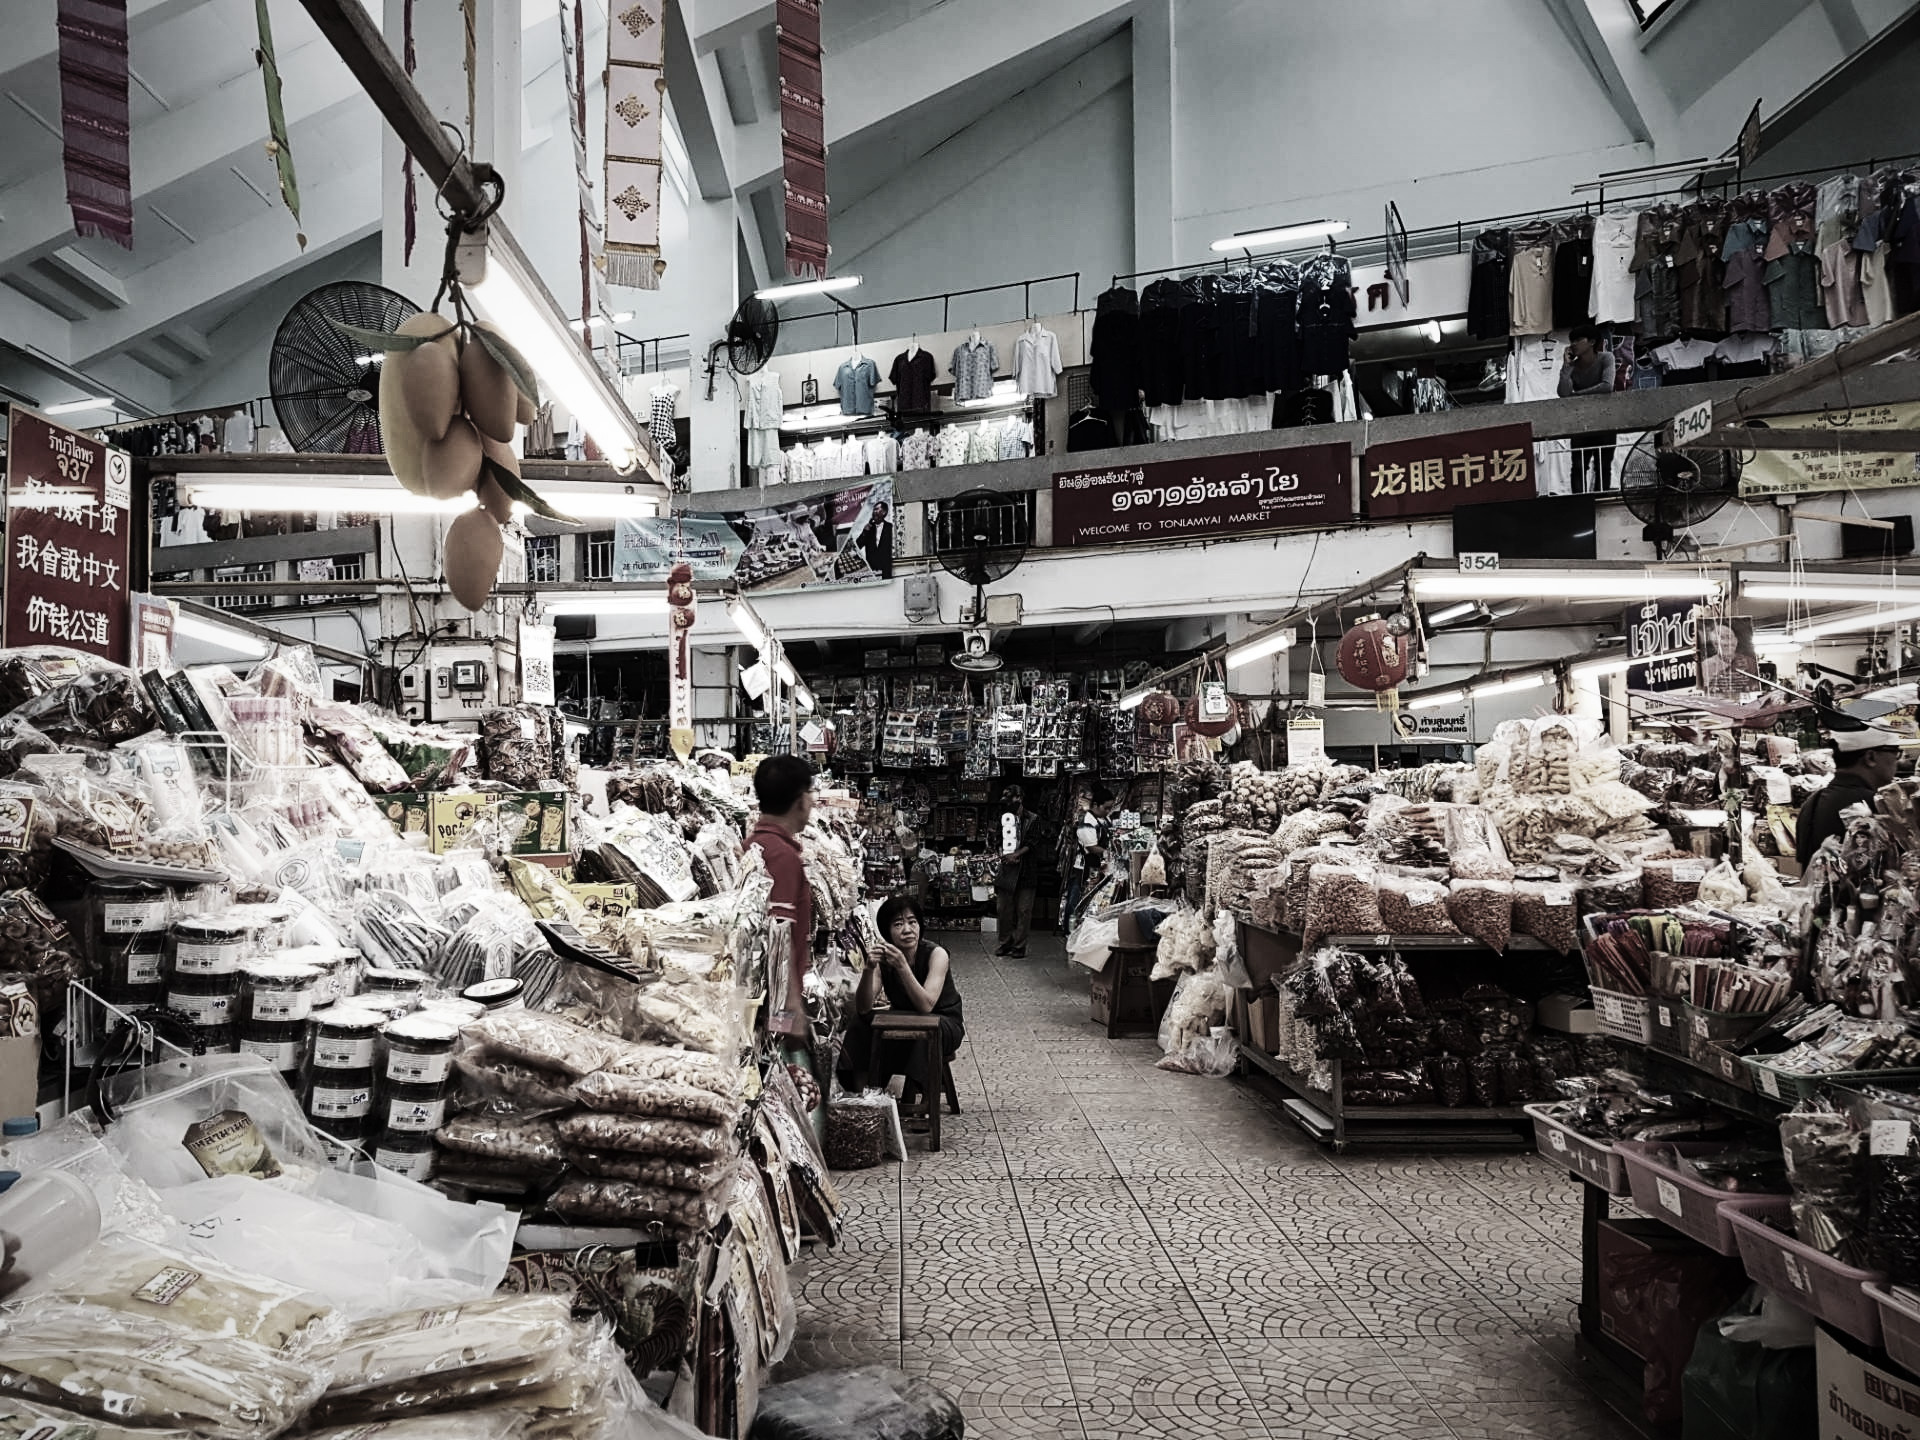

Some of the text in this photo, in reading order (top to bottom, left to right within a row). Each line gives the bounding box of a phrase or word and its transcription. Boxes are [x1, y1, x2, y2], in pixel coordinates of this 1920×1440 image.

[56, 453, 91, 484] จ37
[1111, 466, 1299, 512] ตลาดต้นลำไย
[1370, 448, 1528, 498] 龙眼市场
[1079, 511, 1271, 536] WELCOME TO TONLAMYAI MARKET
[16, 534, 121, 591] 我會說中文
[25, 595, 110, 646] 价钱公道
[1420, 713, 1466, 728] ห้ามสูบบุหรี่
